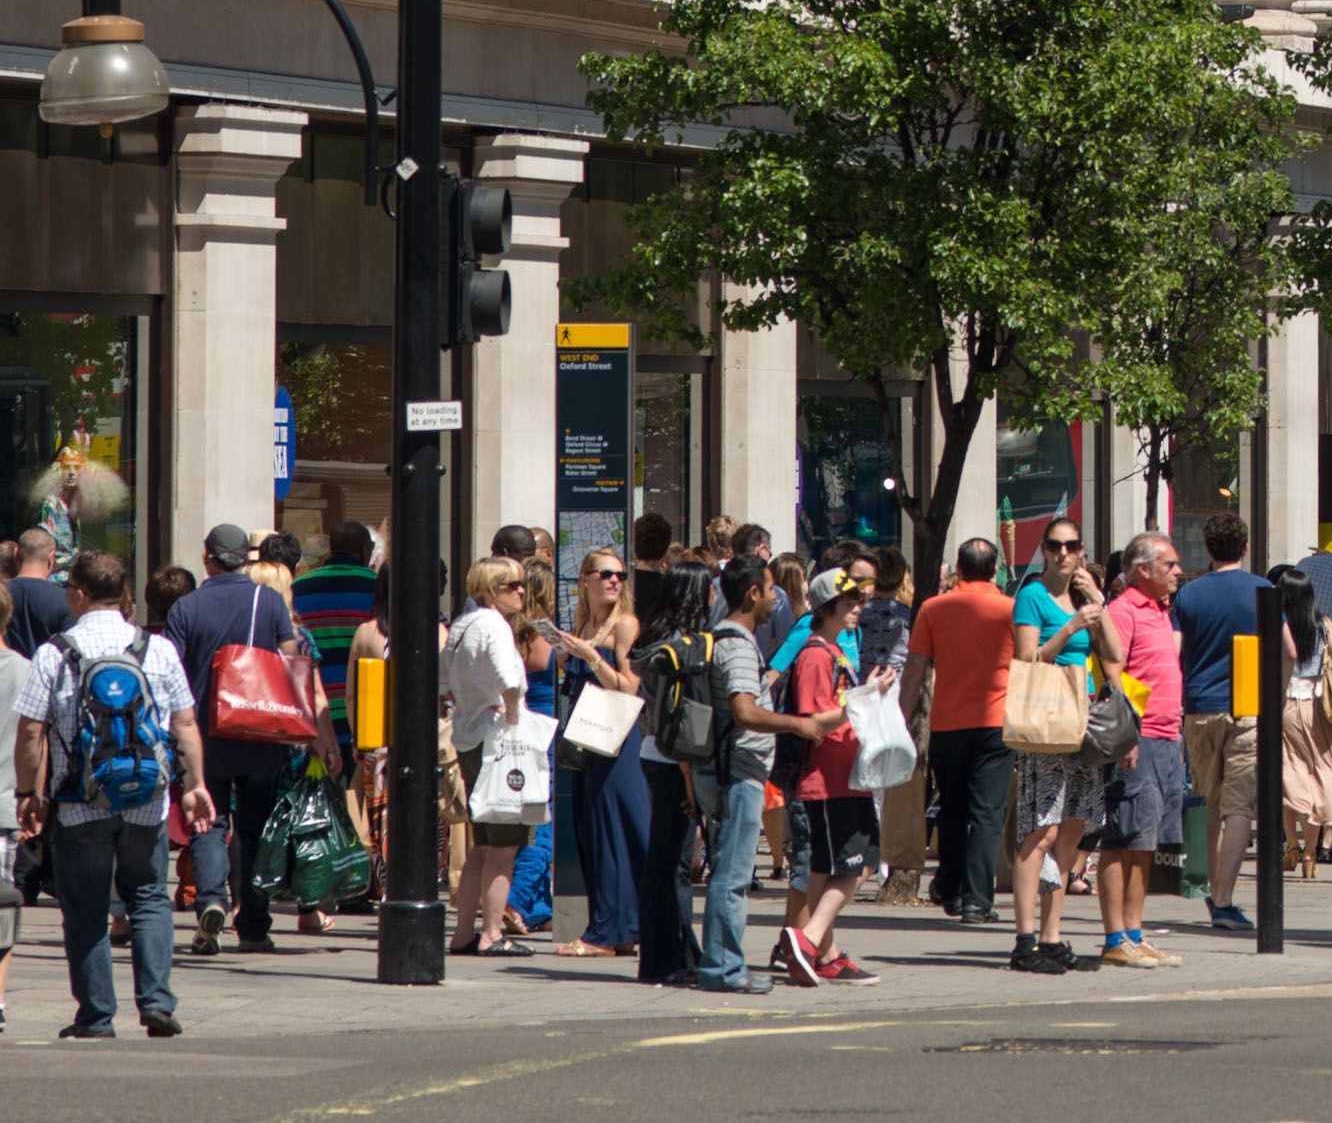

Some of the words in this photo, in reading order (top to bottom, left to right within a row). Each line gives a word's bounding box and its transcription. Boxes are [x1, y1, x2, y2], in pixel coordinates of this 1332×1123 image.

[426, 406, 457, 415] loading
[440, 416, 458, 424] time
[1154, 851, 1188, 868] bour
